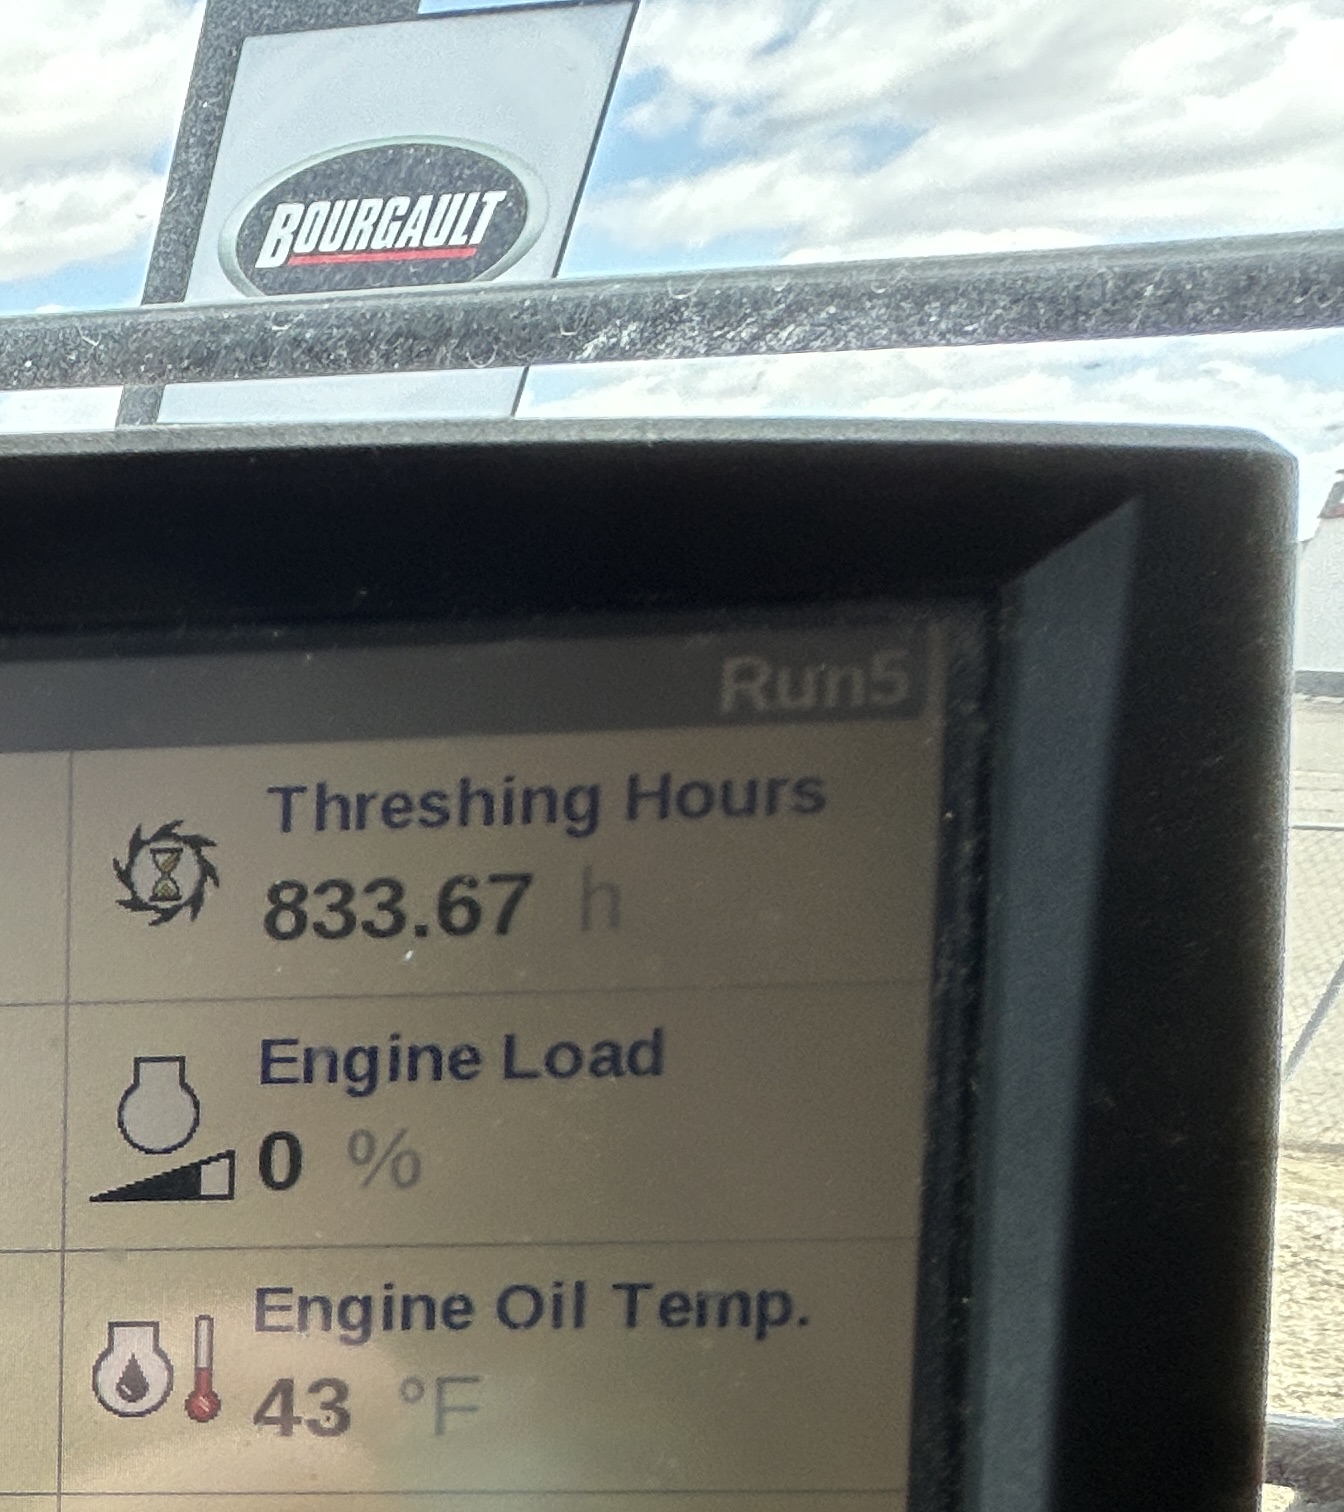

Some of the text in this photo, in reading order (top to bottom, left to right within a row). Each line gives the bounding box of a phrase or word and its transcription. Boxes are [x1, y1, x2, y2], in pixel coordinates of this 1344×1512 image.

[255, 190, 507, 268] BOURGAULT
[720, 655, 911, 713] Run5
[266, 771, 827, 838] Threshing Hours
[264, 865, 620, 940] 833.67 h
[261, 1028, 664, 1097] Engine Load
[259, 1127, 422, 1191] 0 %
[255, 1280, 809, 1346] Engine Oil Temp.
[253, 1375, 482, 1438] 43 °F
